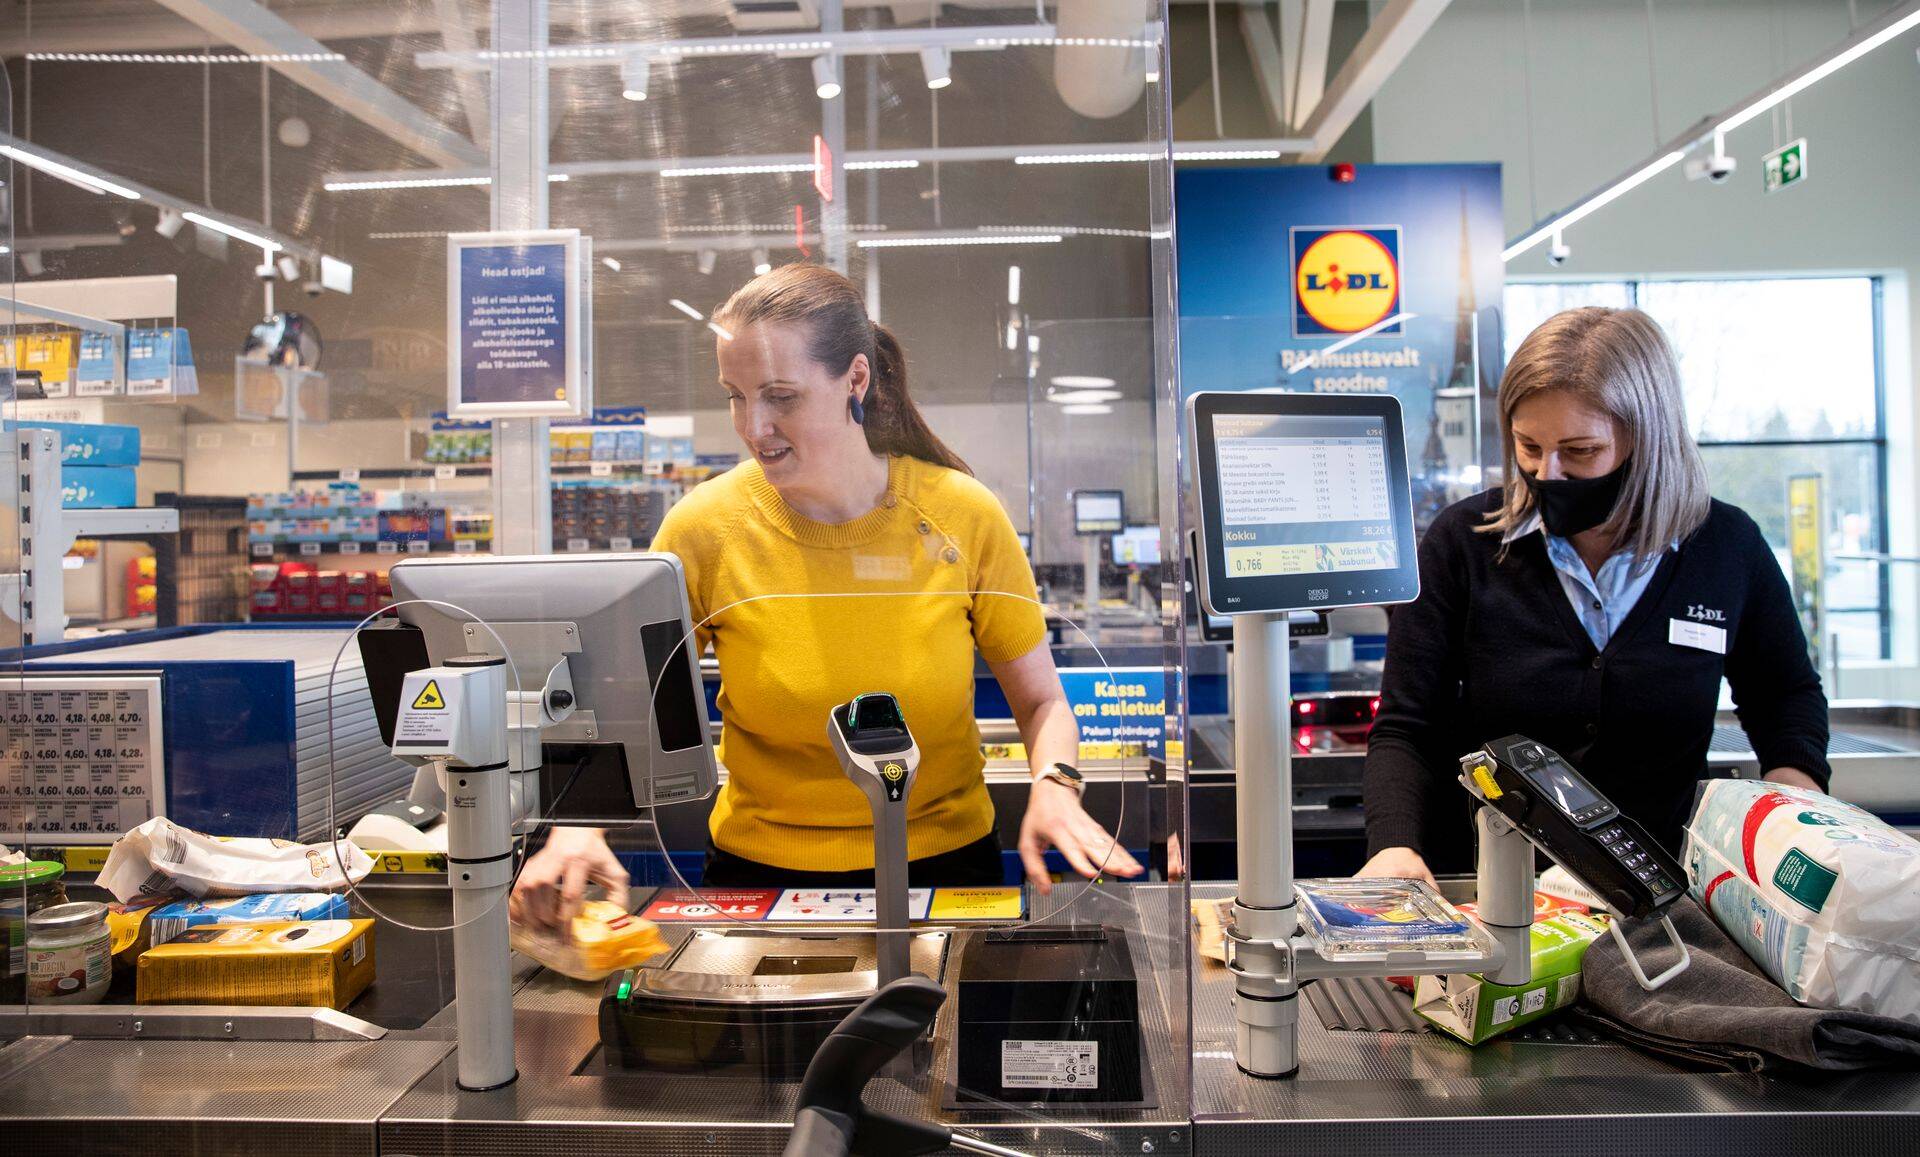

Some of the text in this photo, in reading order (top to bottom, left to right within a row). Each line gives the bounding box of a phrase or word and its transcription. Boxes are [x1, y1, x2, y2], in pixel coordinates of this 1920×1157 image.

[482, 265, 545, 278] Head ostjad!
[472, 295, 488, 304] Lidl
[1313, 372, 1388, 392] soodne
[1225, 531, 1257, 542] Kokku
[1362, 526, 1385, 536] 38,26
[1341, 546, 1372, 556] Värskelt
[1236, 556, 1376, 572] 0,766 saabunud
[1095, 681, 1147, 698] Kassa
[1073, 699, 1165, 716] on suletud
[1082, 725, 1111, 735] Palun
